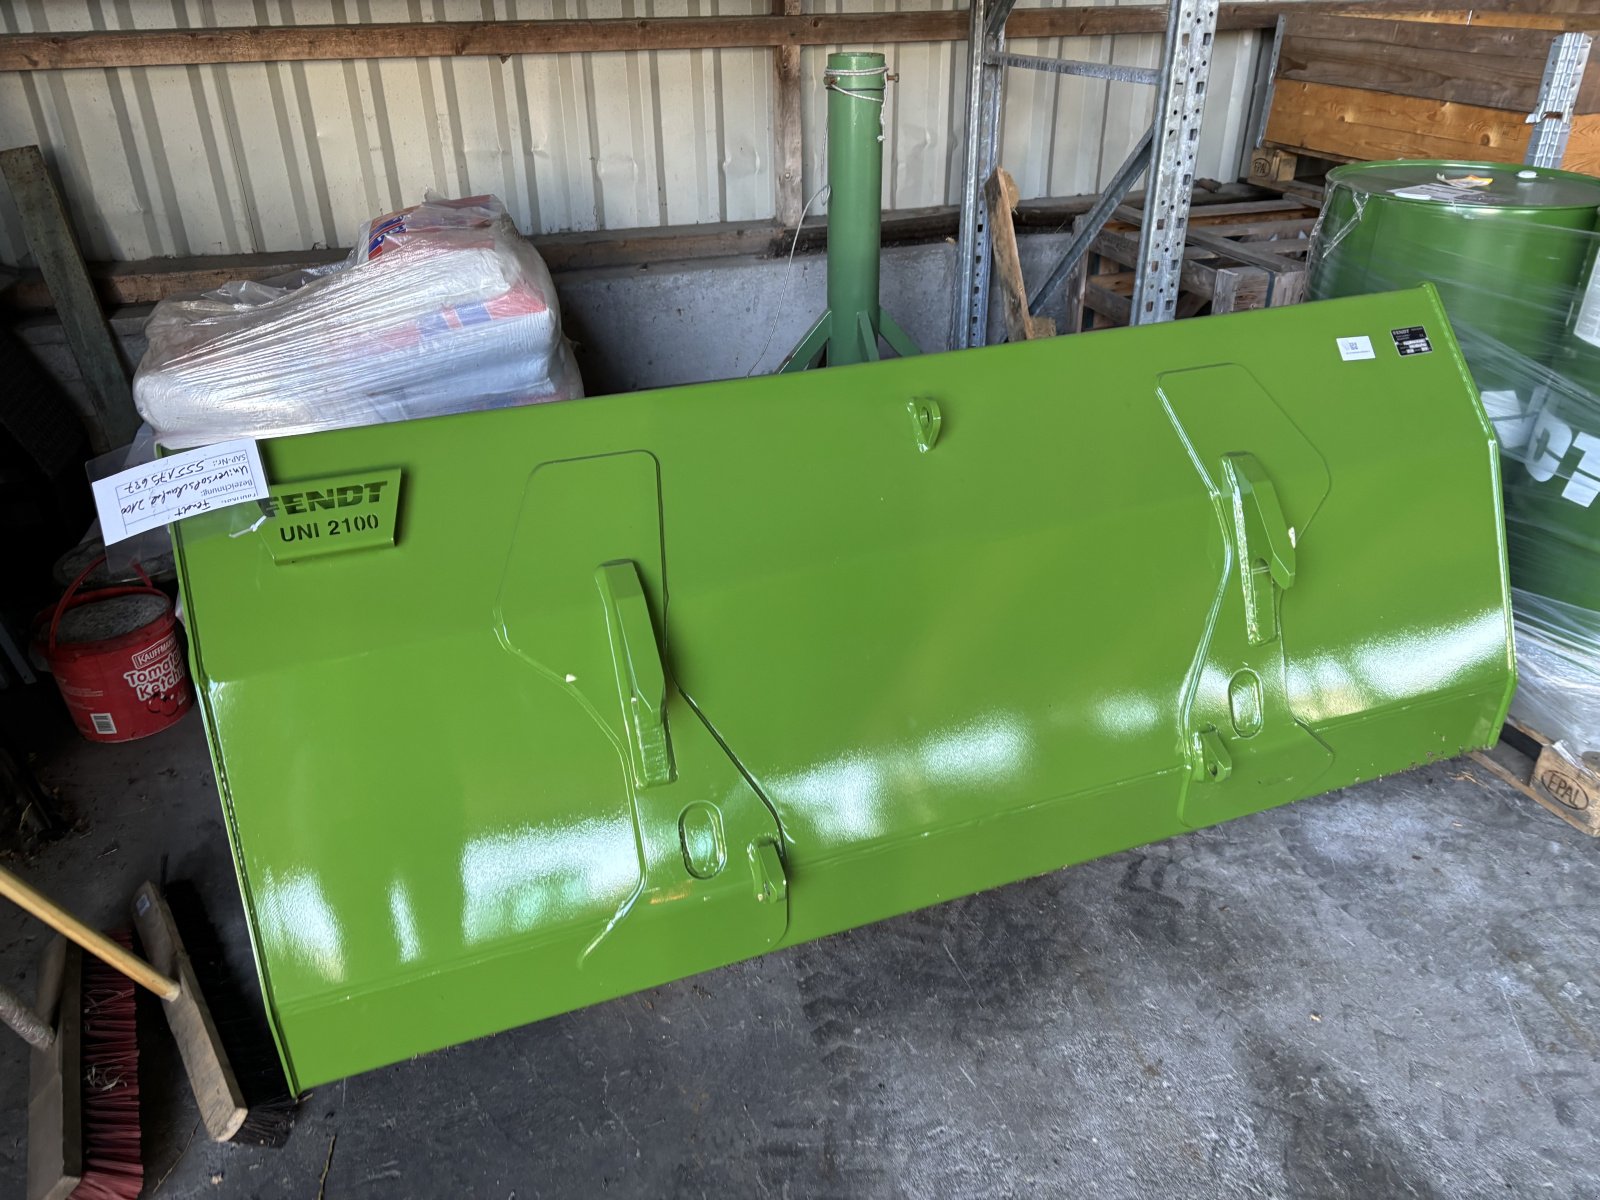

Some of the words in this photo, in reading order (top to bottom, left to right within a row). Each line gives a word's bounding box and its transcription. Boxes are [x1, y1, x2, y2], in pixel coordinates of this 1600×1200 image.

[212, 453, 247, 467] SAP-Nr.:
[201, 479, 253, 497] Bezeichnung:
[262, 481, 388, 517] FENDT
[174, 499, 211, 517] Fendt
[280, 523, 319, 542] UNI
[328, 514, 379, 535] 2100
[124, 645, 181, 687] Tomate
[1548, 773, 1580, 808] EPAL
